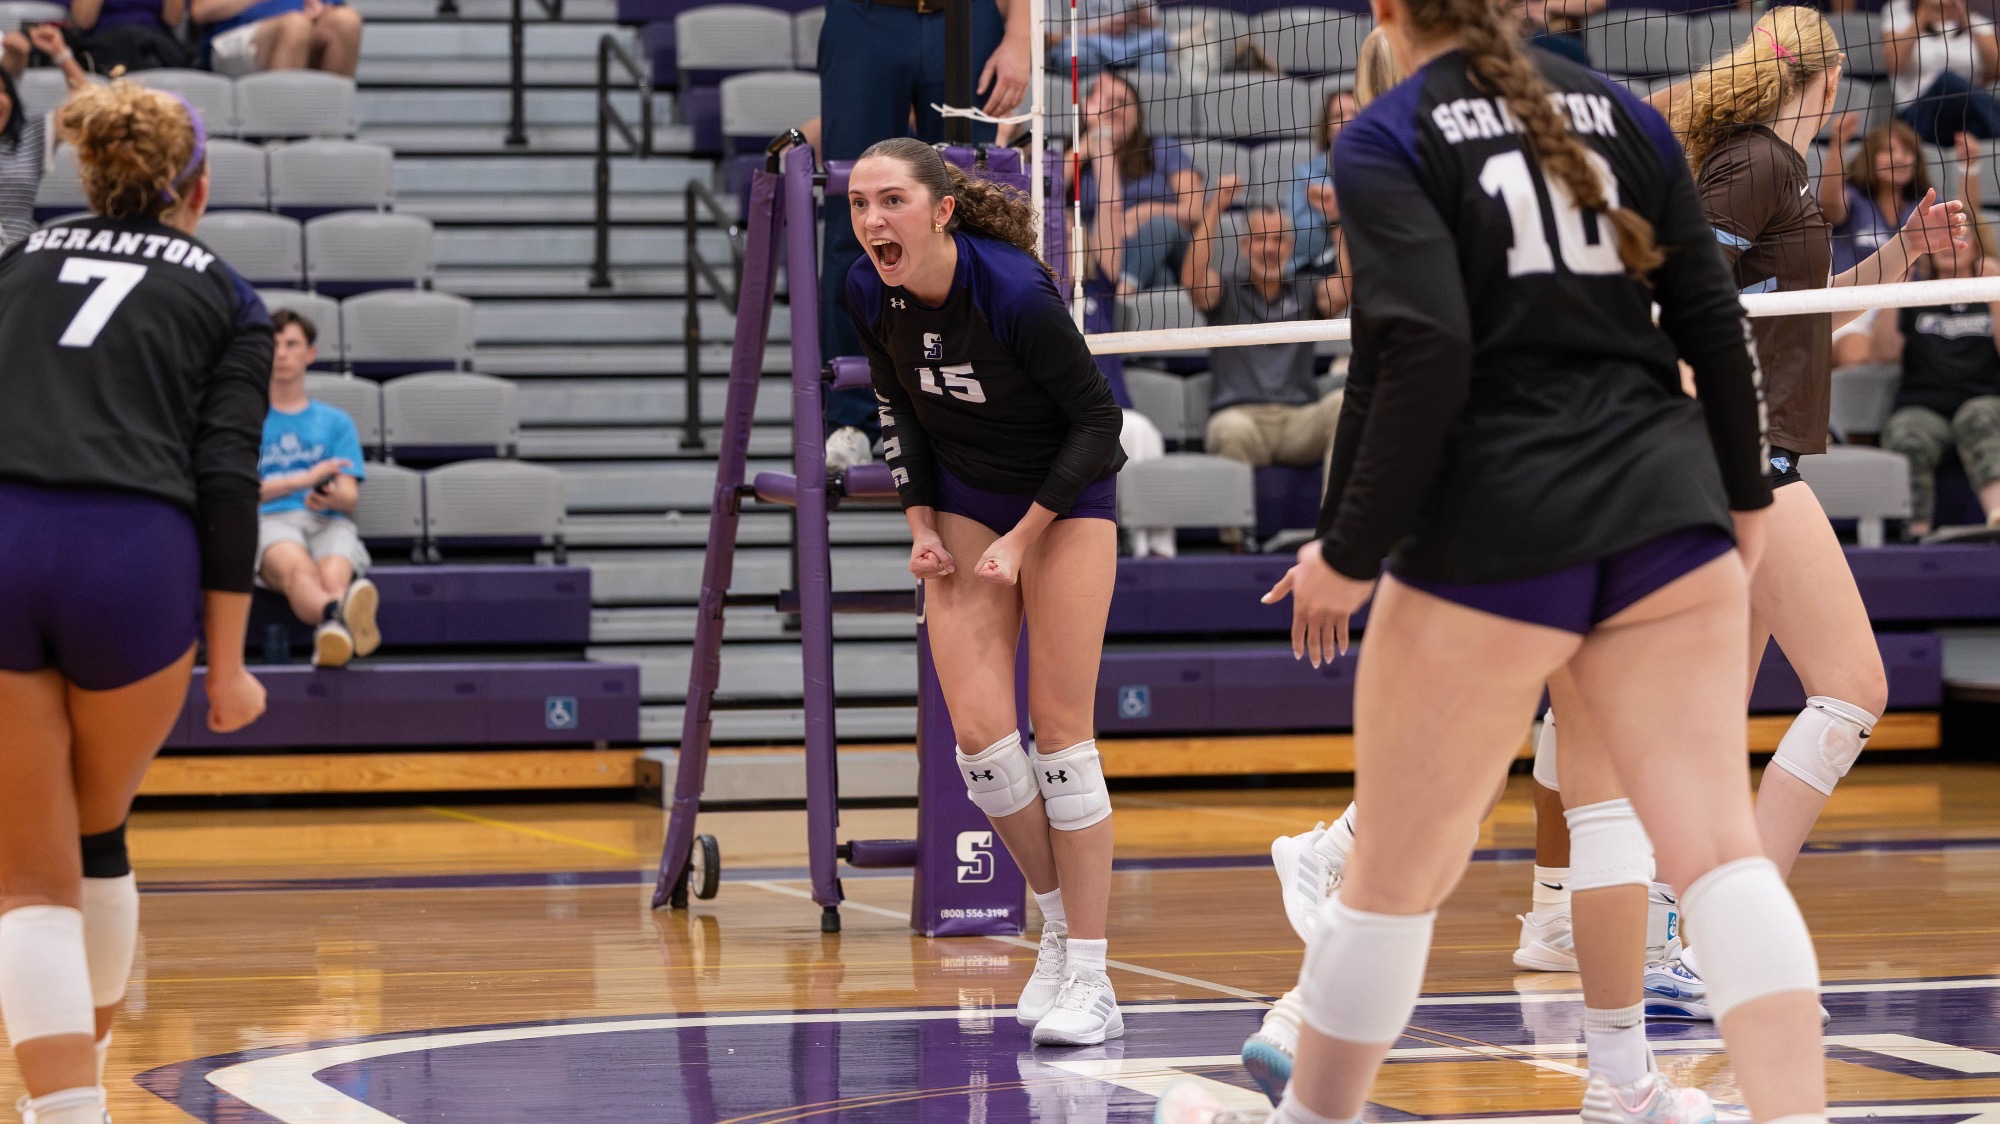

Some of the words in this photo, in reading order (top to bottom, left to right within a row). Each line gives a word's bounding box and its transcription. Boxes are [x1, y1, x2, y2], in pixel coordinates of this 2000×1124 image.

[1432, 92, 1617, 144] SCRAON
[1478, 149, 1626, 278] 10
[24, 227, 216, 273] SCRANTON
[57, 257, 148, 348] 7
[923, 332, 943, 360] S
[915, 361, 987, 404] 15
[956, 831, 994, 883] S
[940, 909, 965, 919] (800)
[966, 908, 1009, 918] 556-3198
